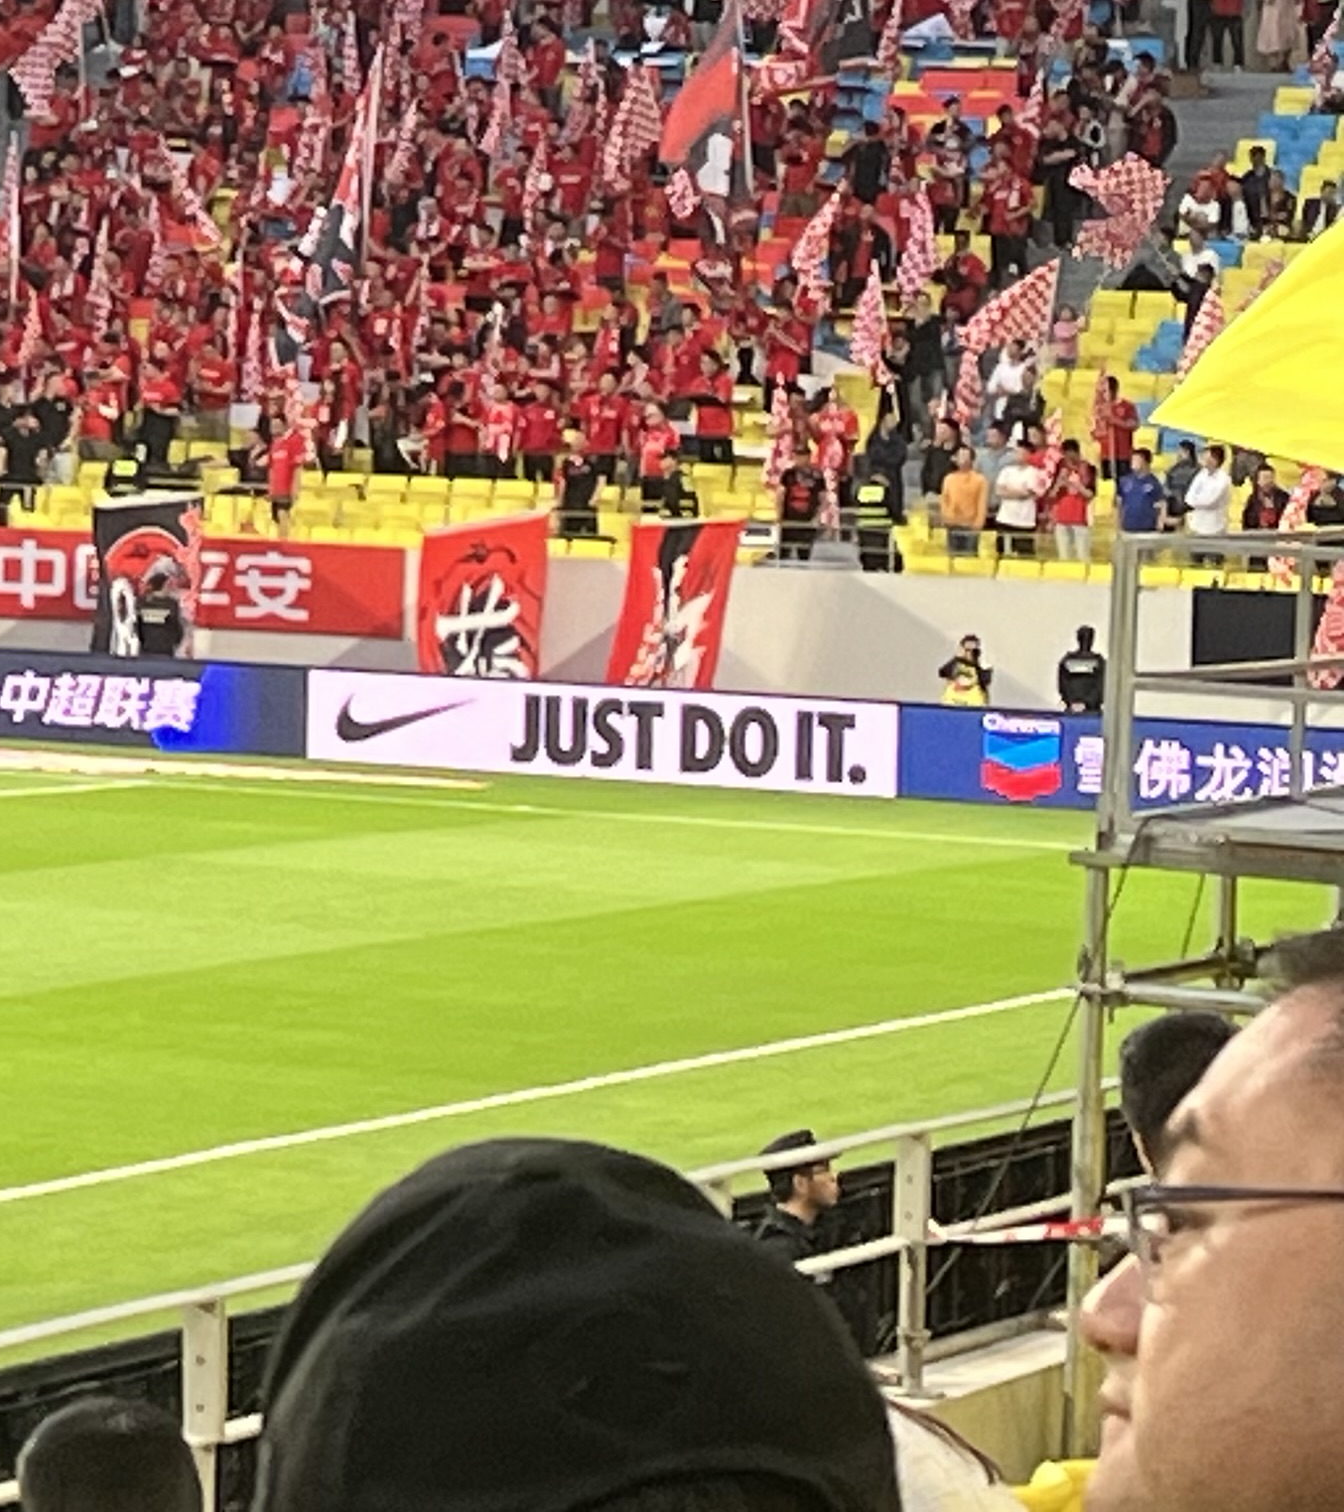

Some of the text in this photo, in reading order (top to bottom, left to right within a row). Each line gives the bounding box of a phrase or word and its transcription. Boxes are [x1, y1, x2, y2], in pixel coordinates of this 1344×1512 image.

[510, 693, 867, 786] JUST DO IT.
